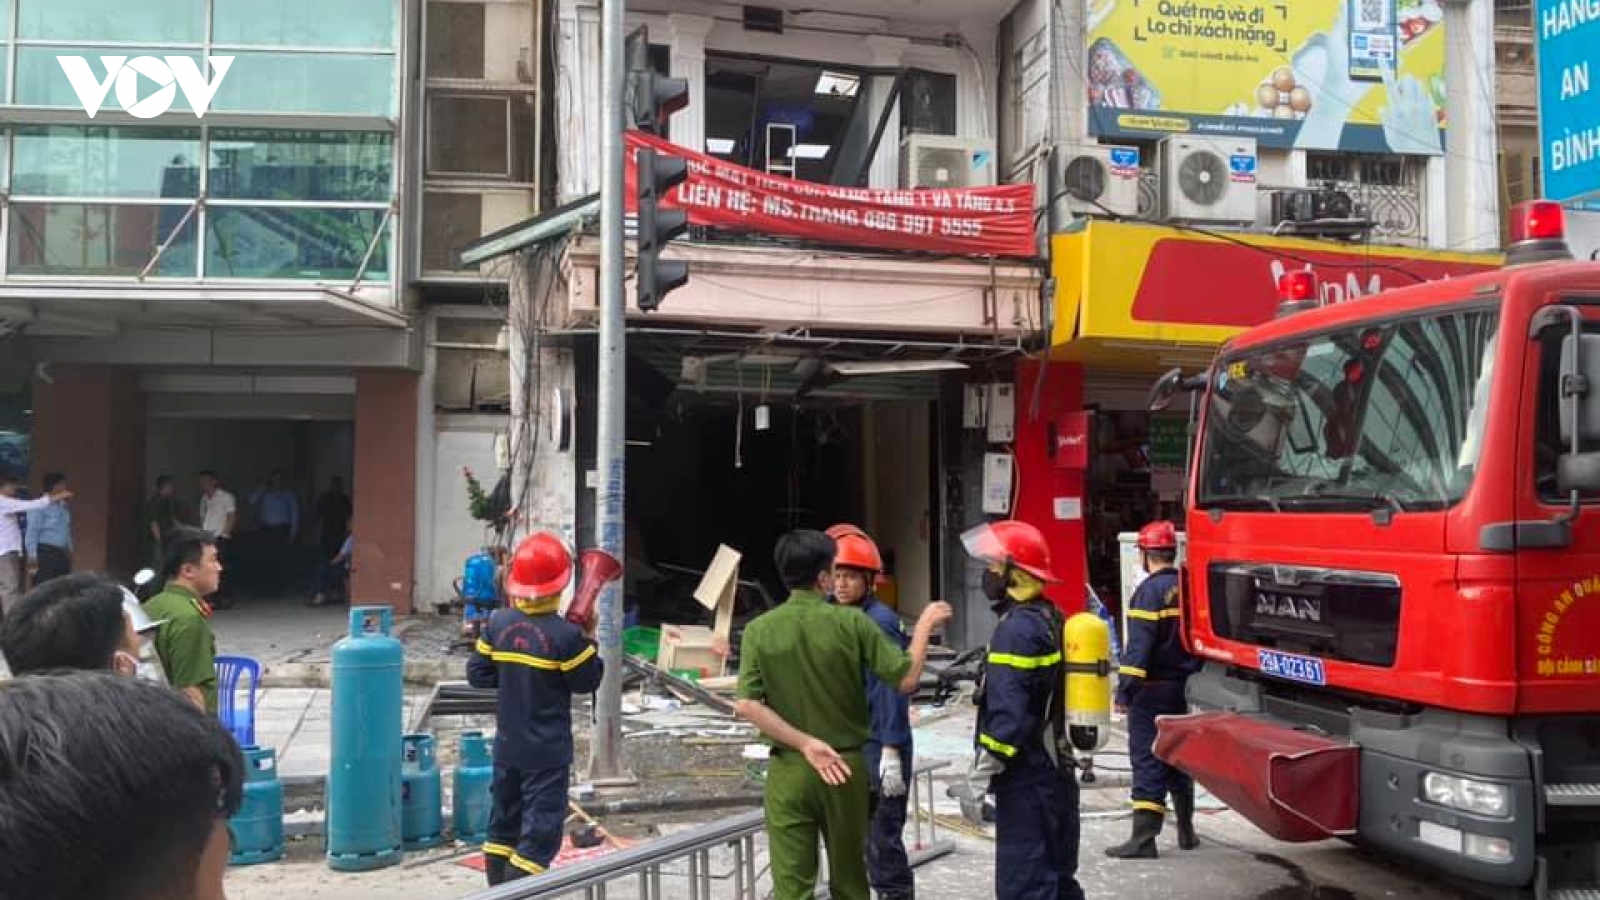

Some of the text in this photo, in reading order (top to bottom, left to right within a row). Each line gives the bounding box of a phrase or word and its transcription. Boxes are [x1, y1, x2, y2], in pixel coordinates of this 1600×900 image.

[1228, 6, 1246, 22] và
[1249, 7, 1264, 23] đi
[1147, 17, 1275, 47] Lo chi xách nặng
[1560, 60, 1589, 100] AN
[1552, 127, 1600, 171] BÌNH
[678, 180, 721, 208] LIÊN
[726, 184, 758, 215] HỆ:
[931, 190, 951, 209] VÀ
[1256, 594, 1320, 620] MAN
